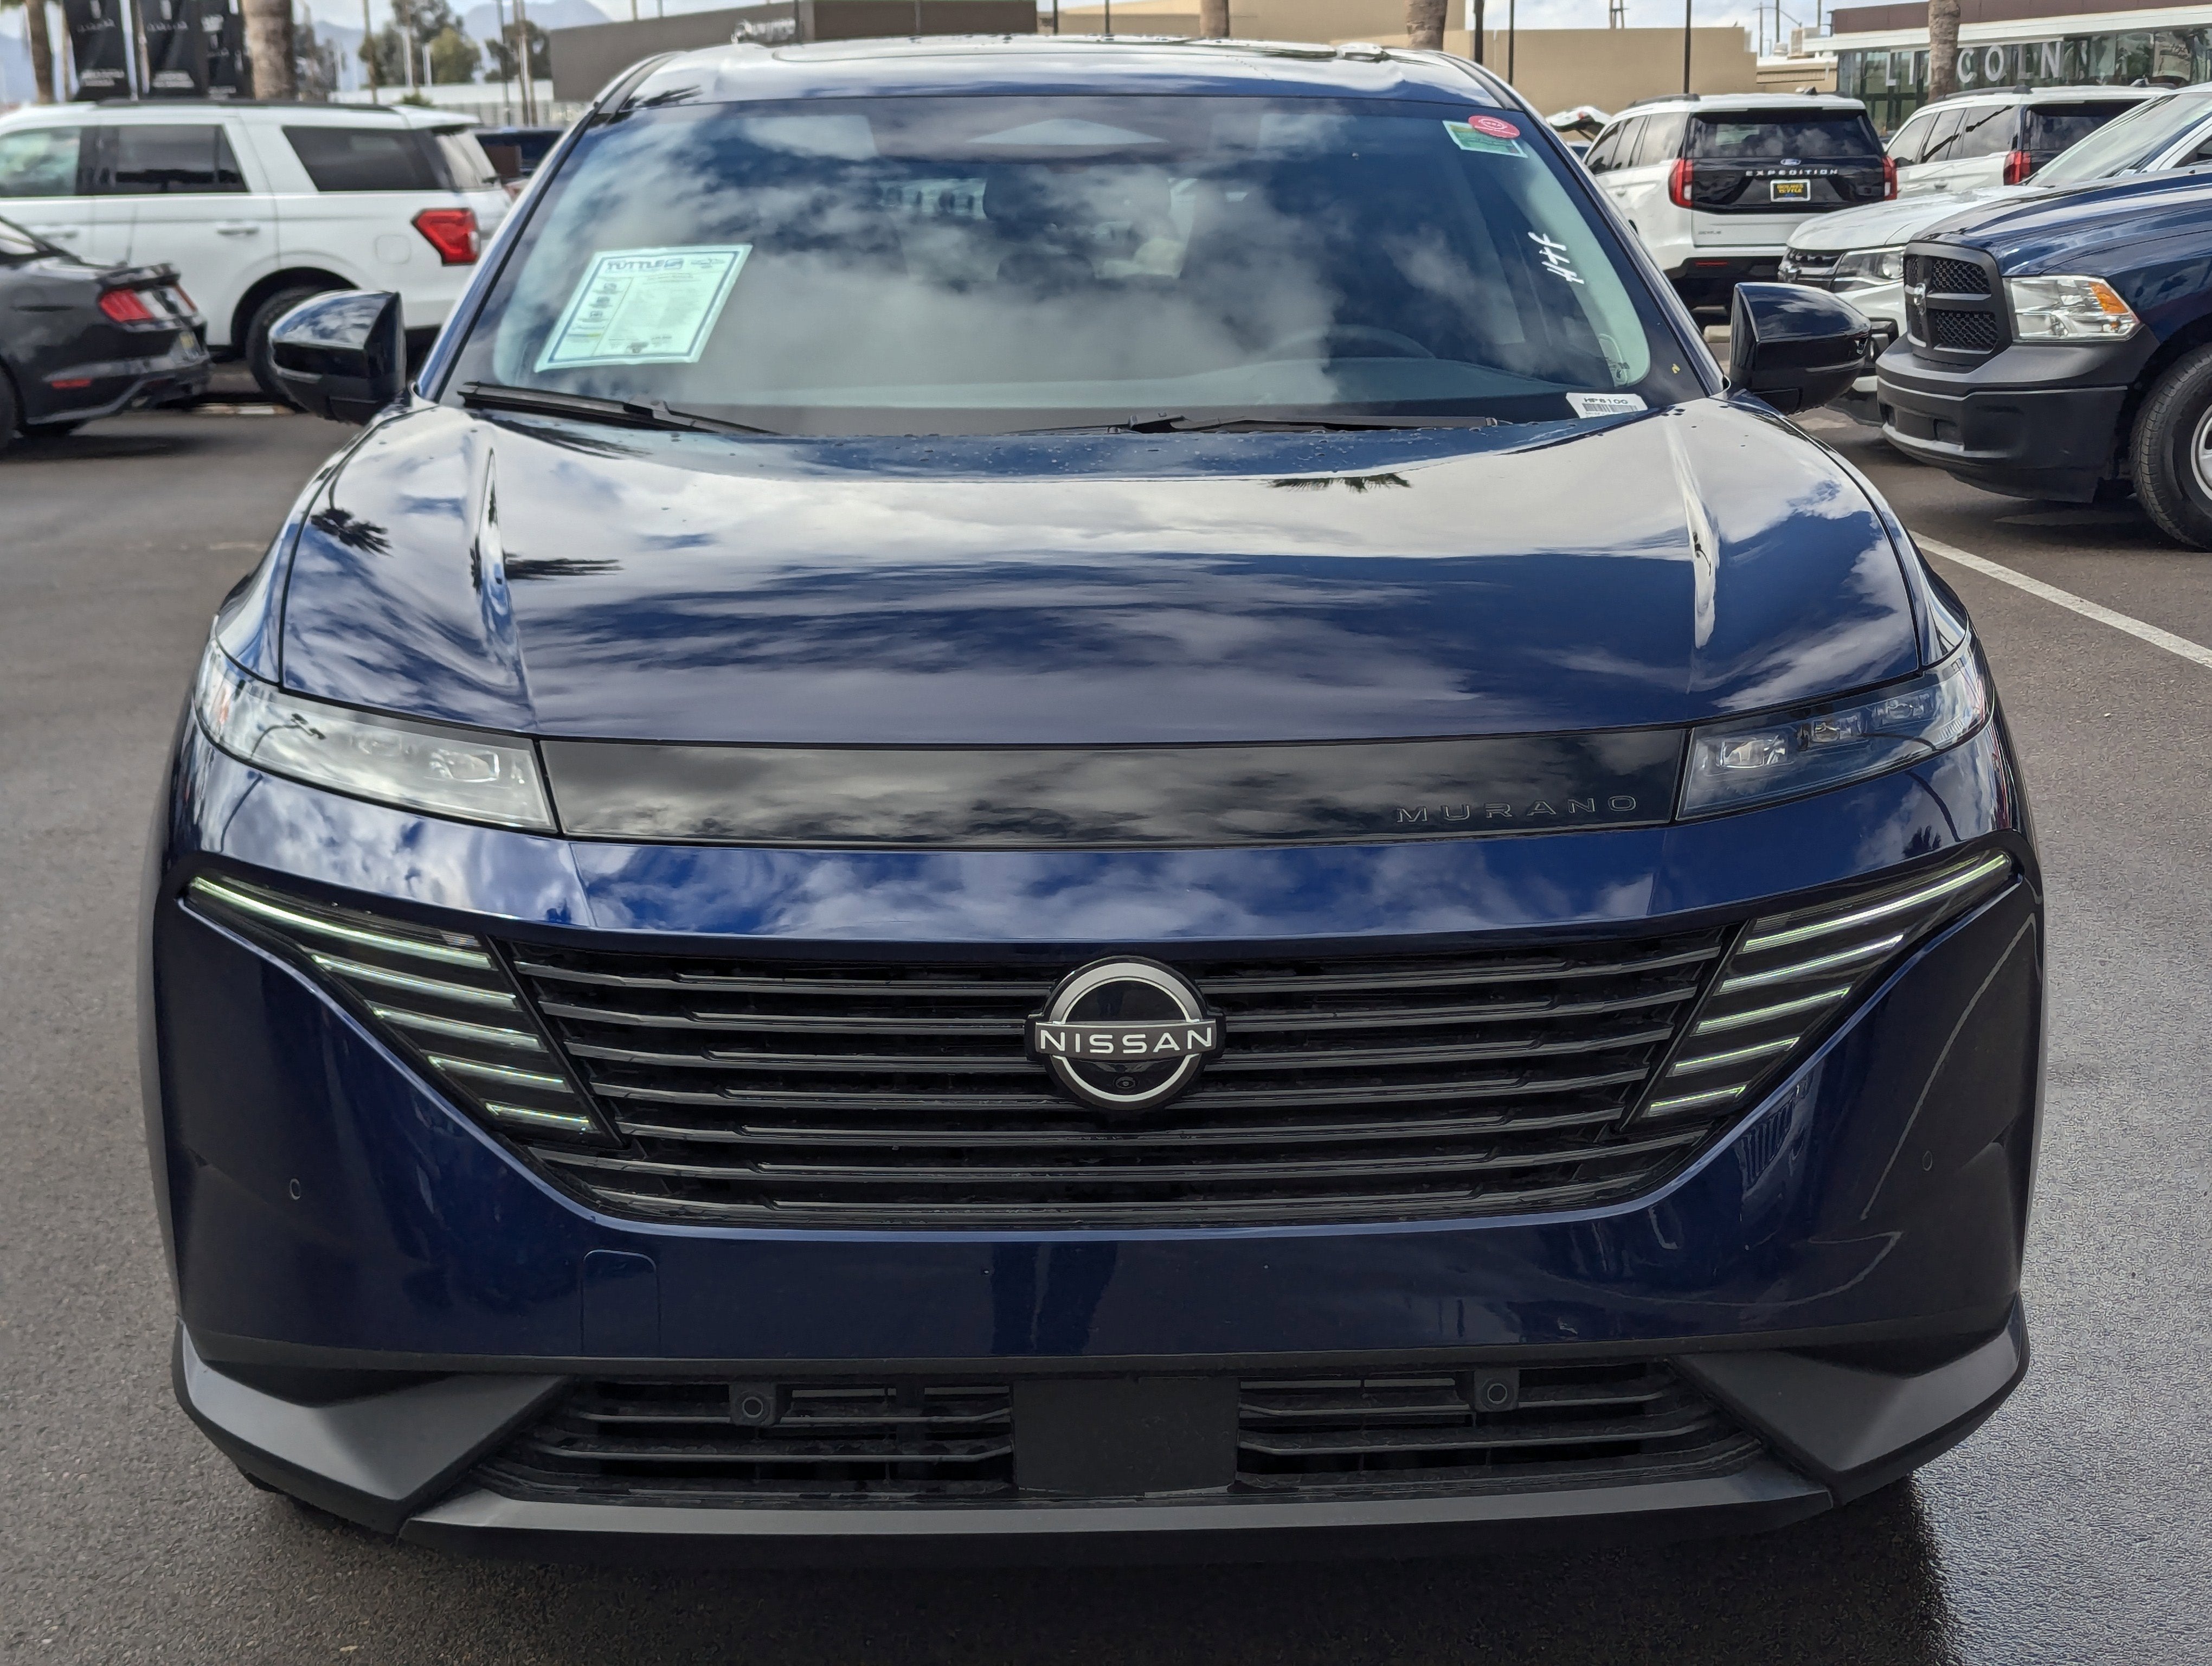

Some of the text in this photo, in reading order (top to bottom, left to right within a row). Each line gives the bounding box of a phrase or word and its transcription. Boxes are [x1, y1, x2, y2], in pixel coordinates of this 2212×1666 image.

[1885, 41, 2061, 86] LICOLN
[1397, 795, 1636, 823] MURANO
[1040, 1027, 1212, 1054] NISSAN
